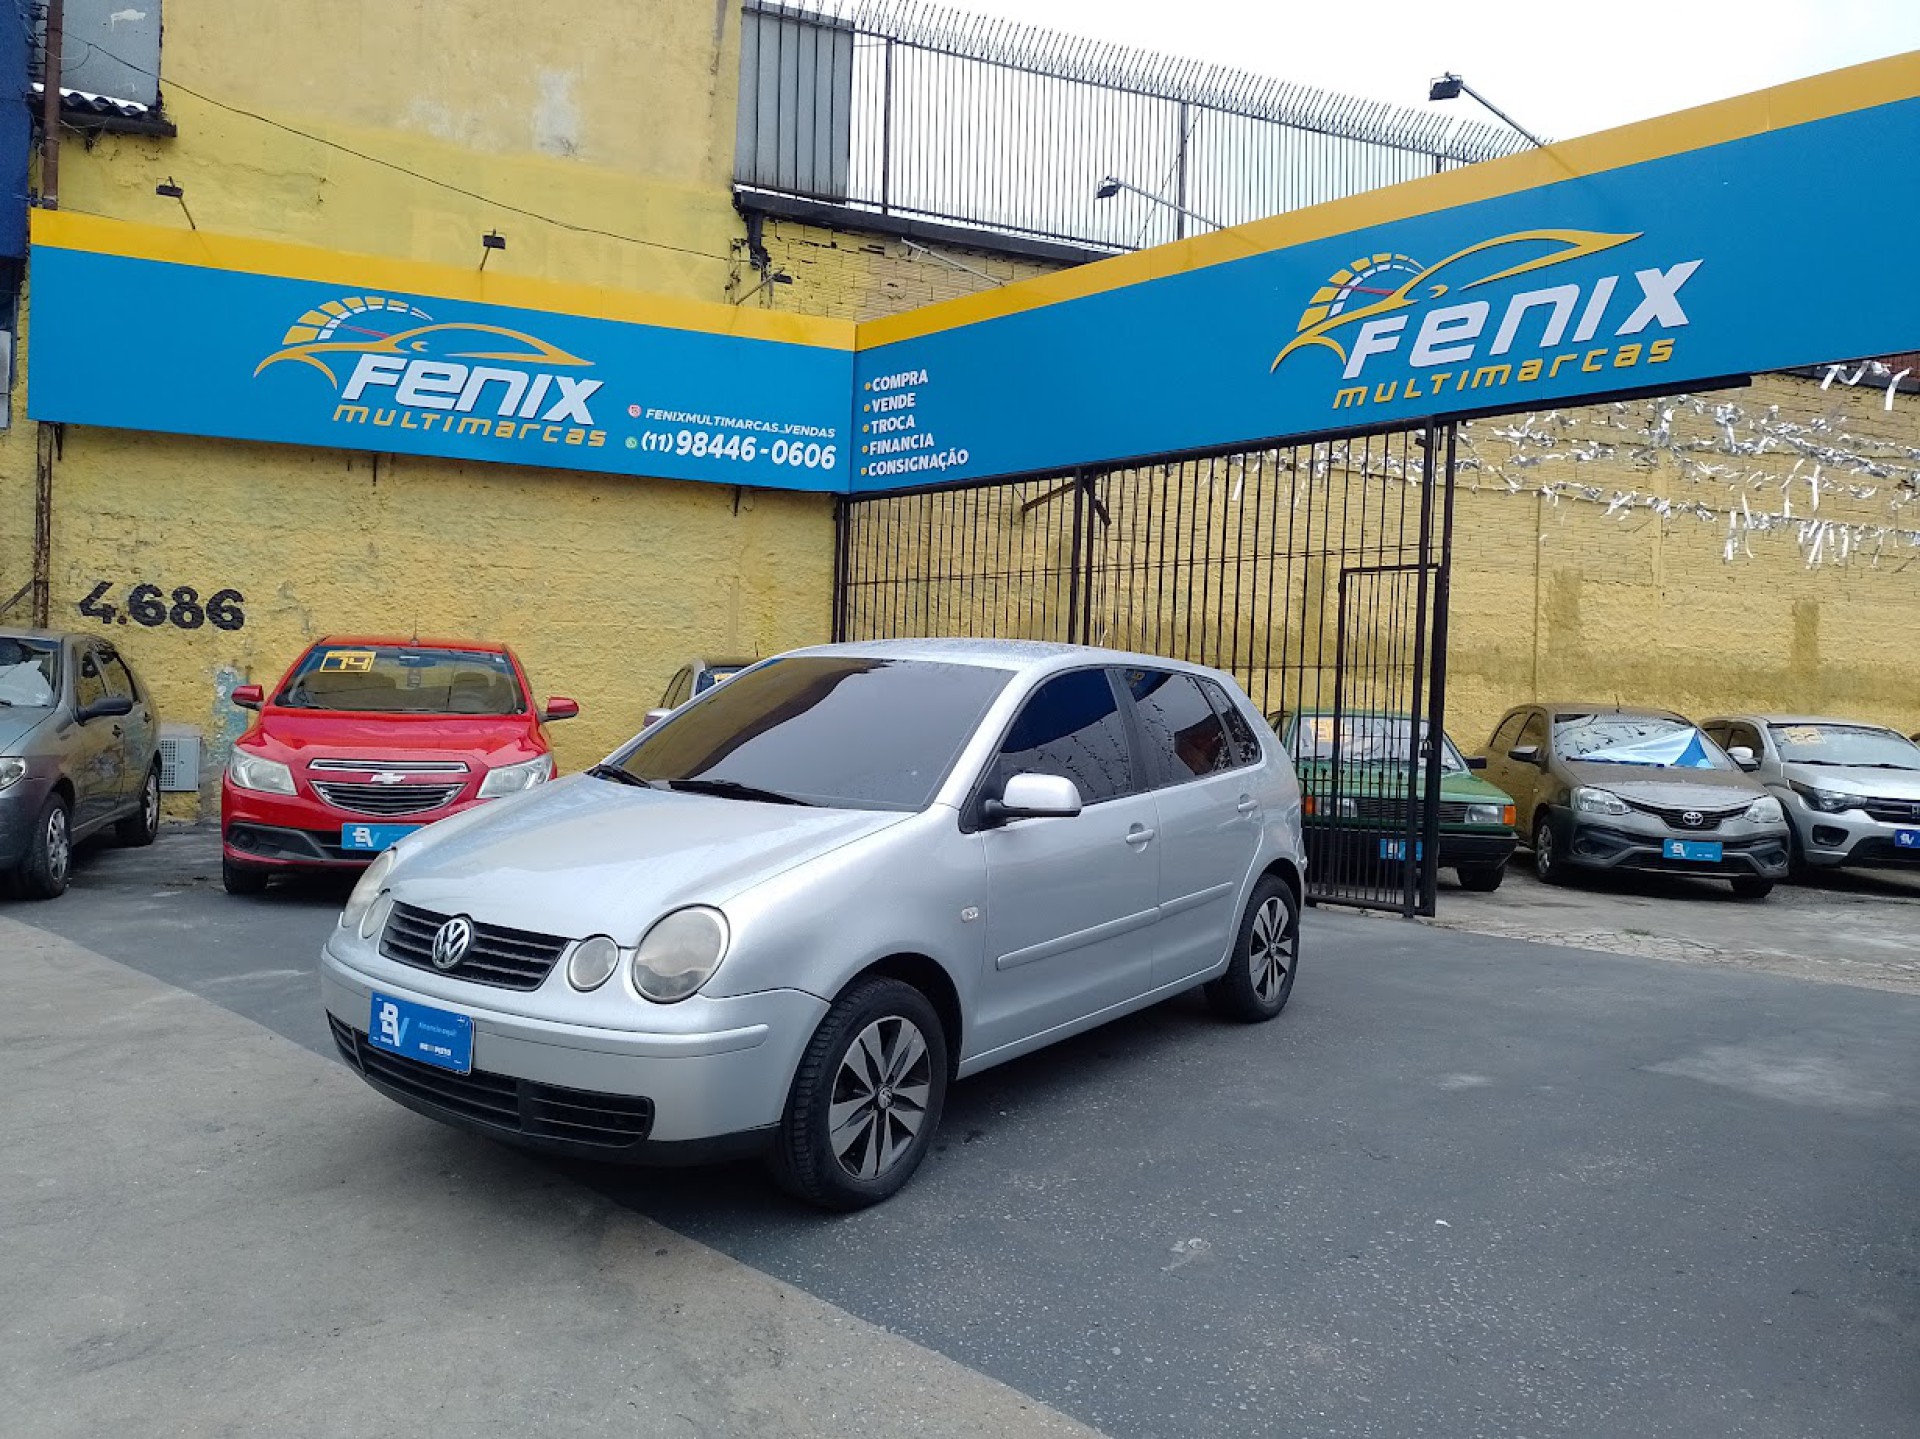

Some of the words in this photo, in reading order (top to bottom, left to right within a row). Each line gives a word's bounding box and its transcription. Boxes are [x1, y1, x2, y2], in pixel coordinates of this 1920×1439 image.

[872, 369, 928, 391] COMPRA
[872, 392, 916, 413] VENDE
[871, 414, 916, 435] TROCA
[869, 432, 935, 456] FINANCIA
[868, 447, 969, 477] CONSIGNAÇÃO
[79, 580, 246, 631] 4.686
